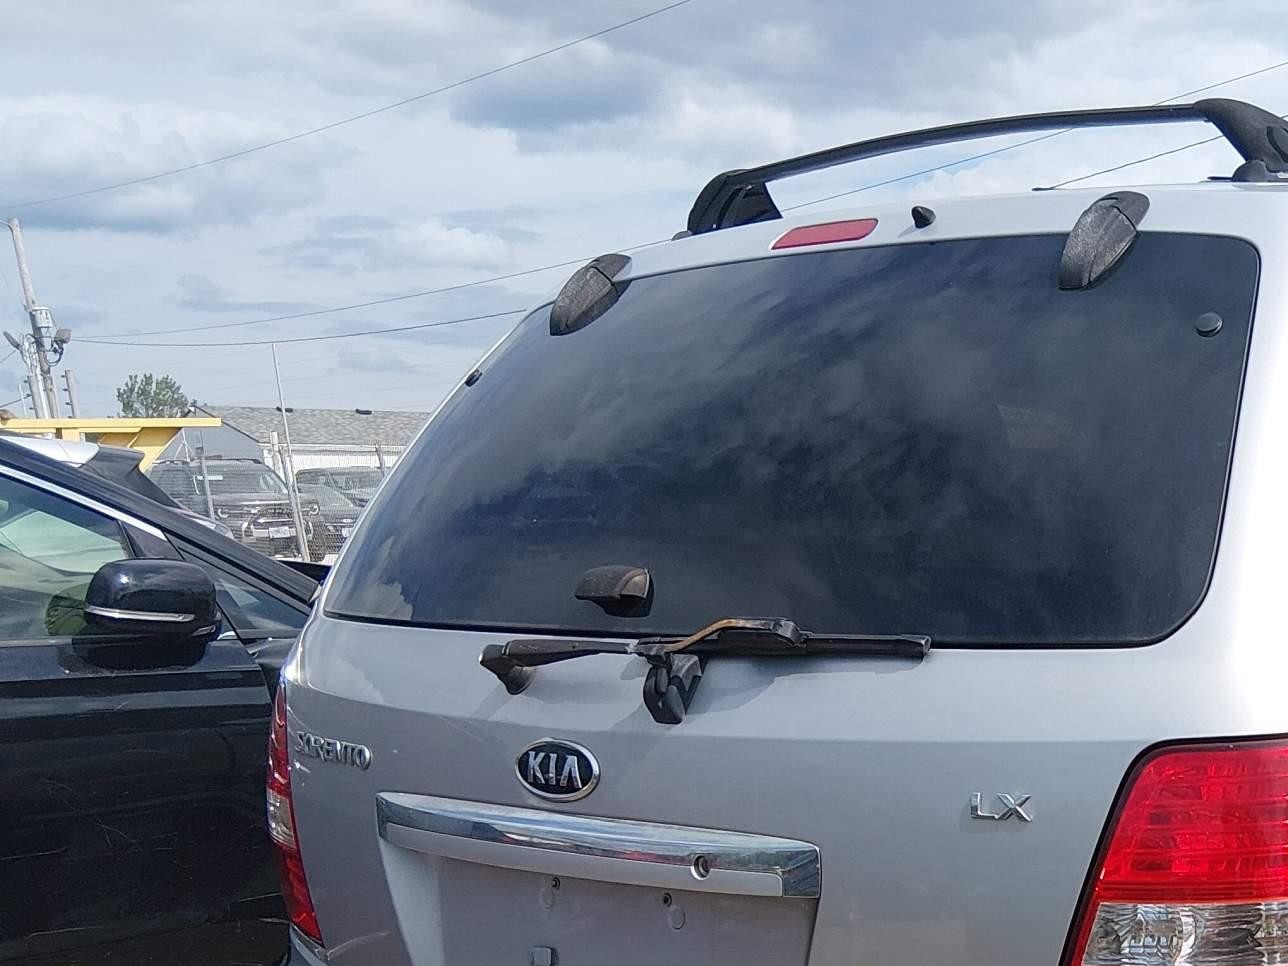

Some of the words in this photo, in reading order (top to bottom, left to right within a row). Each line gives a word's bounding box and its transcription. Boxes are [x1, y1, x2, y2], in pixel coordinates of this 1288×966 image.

[295, 730, 373, 770] SORENTO
[527, 750, 582, 789] KIA
[969, 791, 1032, 822] LX
